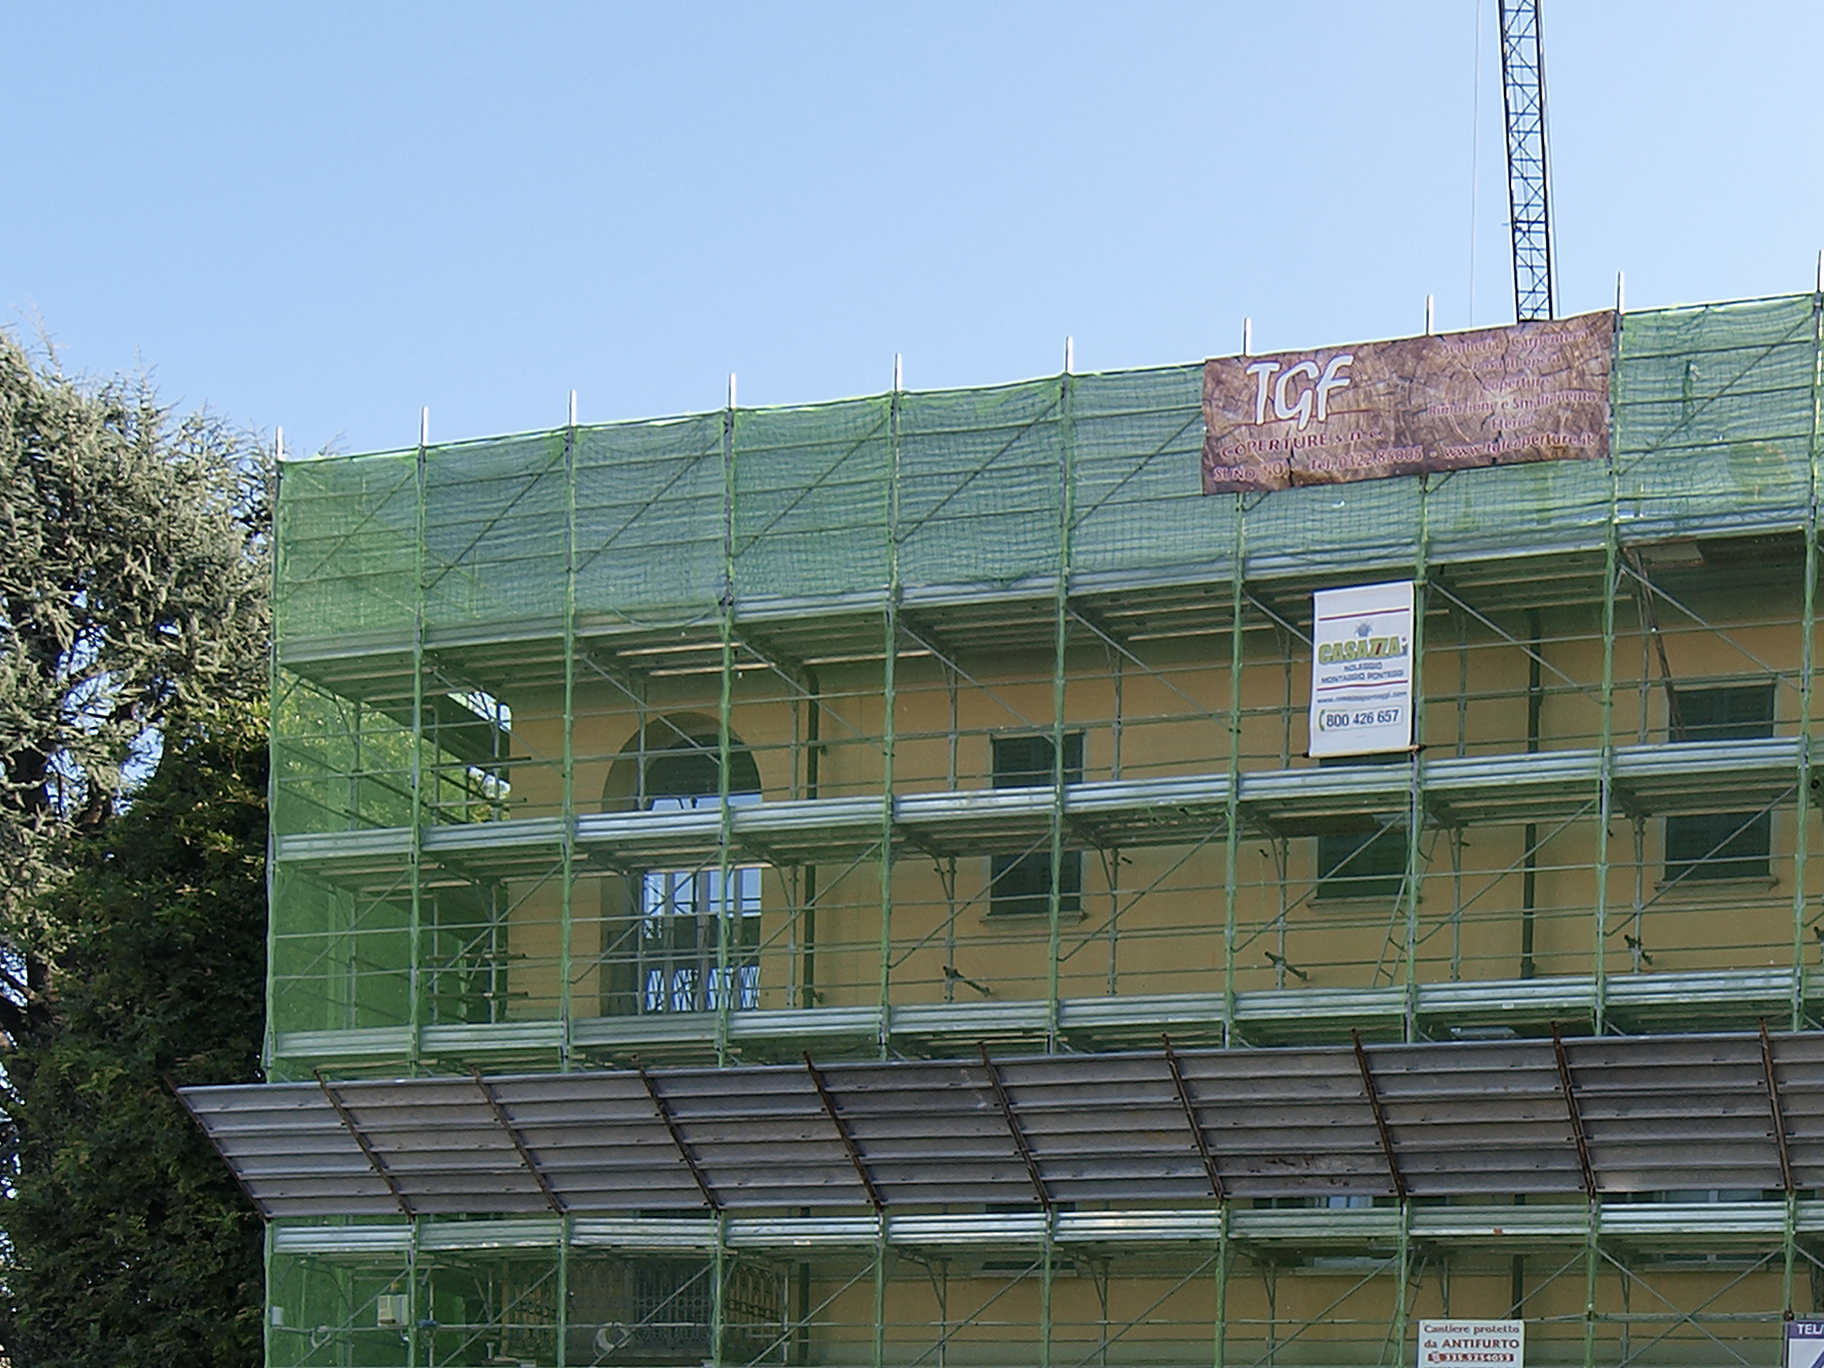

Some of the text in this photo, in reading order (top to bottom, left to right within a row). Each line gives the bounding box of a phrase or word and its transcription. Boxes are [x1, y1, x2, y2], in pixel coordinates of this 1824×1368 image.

[1246, 354, 1355, 430] TGF
[1220, 434, 1329, 459] COPERTURE
[1318, 636, 1400, 664] CASAZZA
[1326, 709, 1399, 727] 800 426 657
[1424, 1324, 1520, 1335] Cantiere protetto
[1424, 1339, 1520, 1349] da ANTIFURTO
